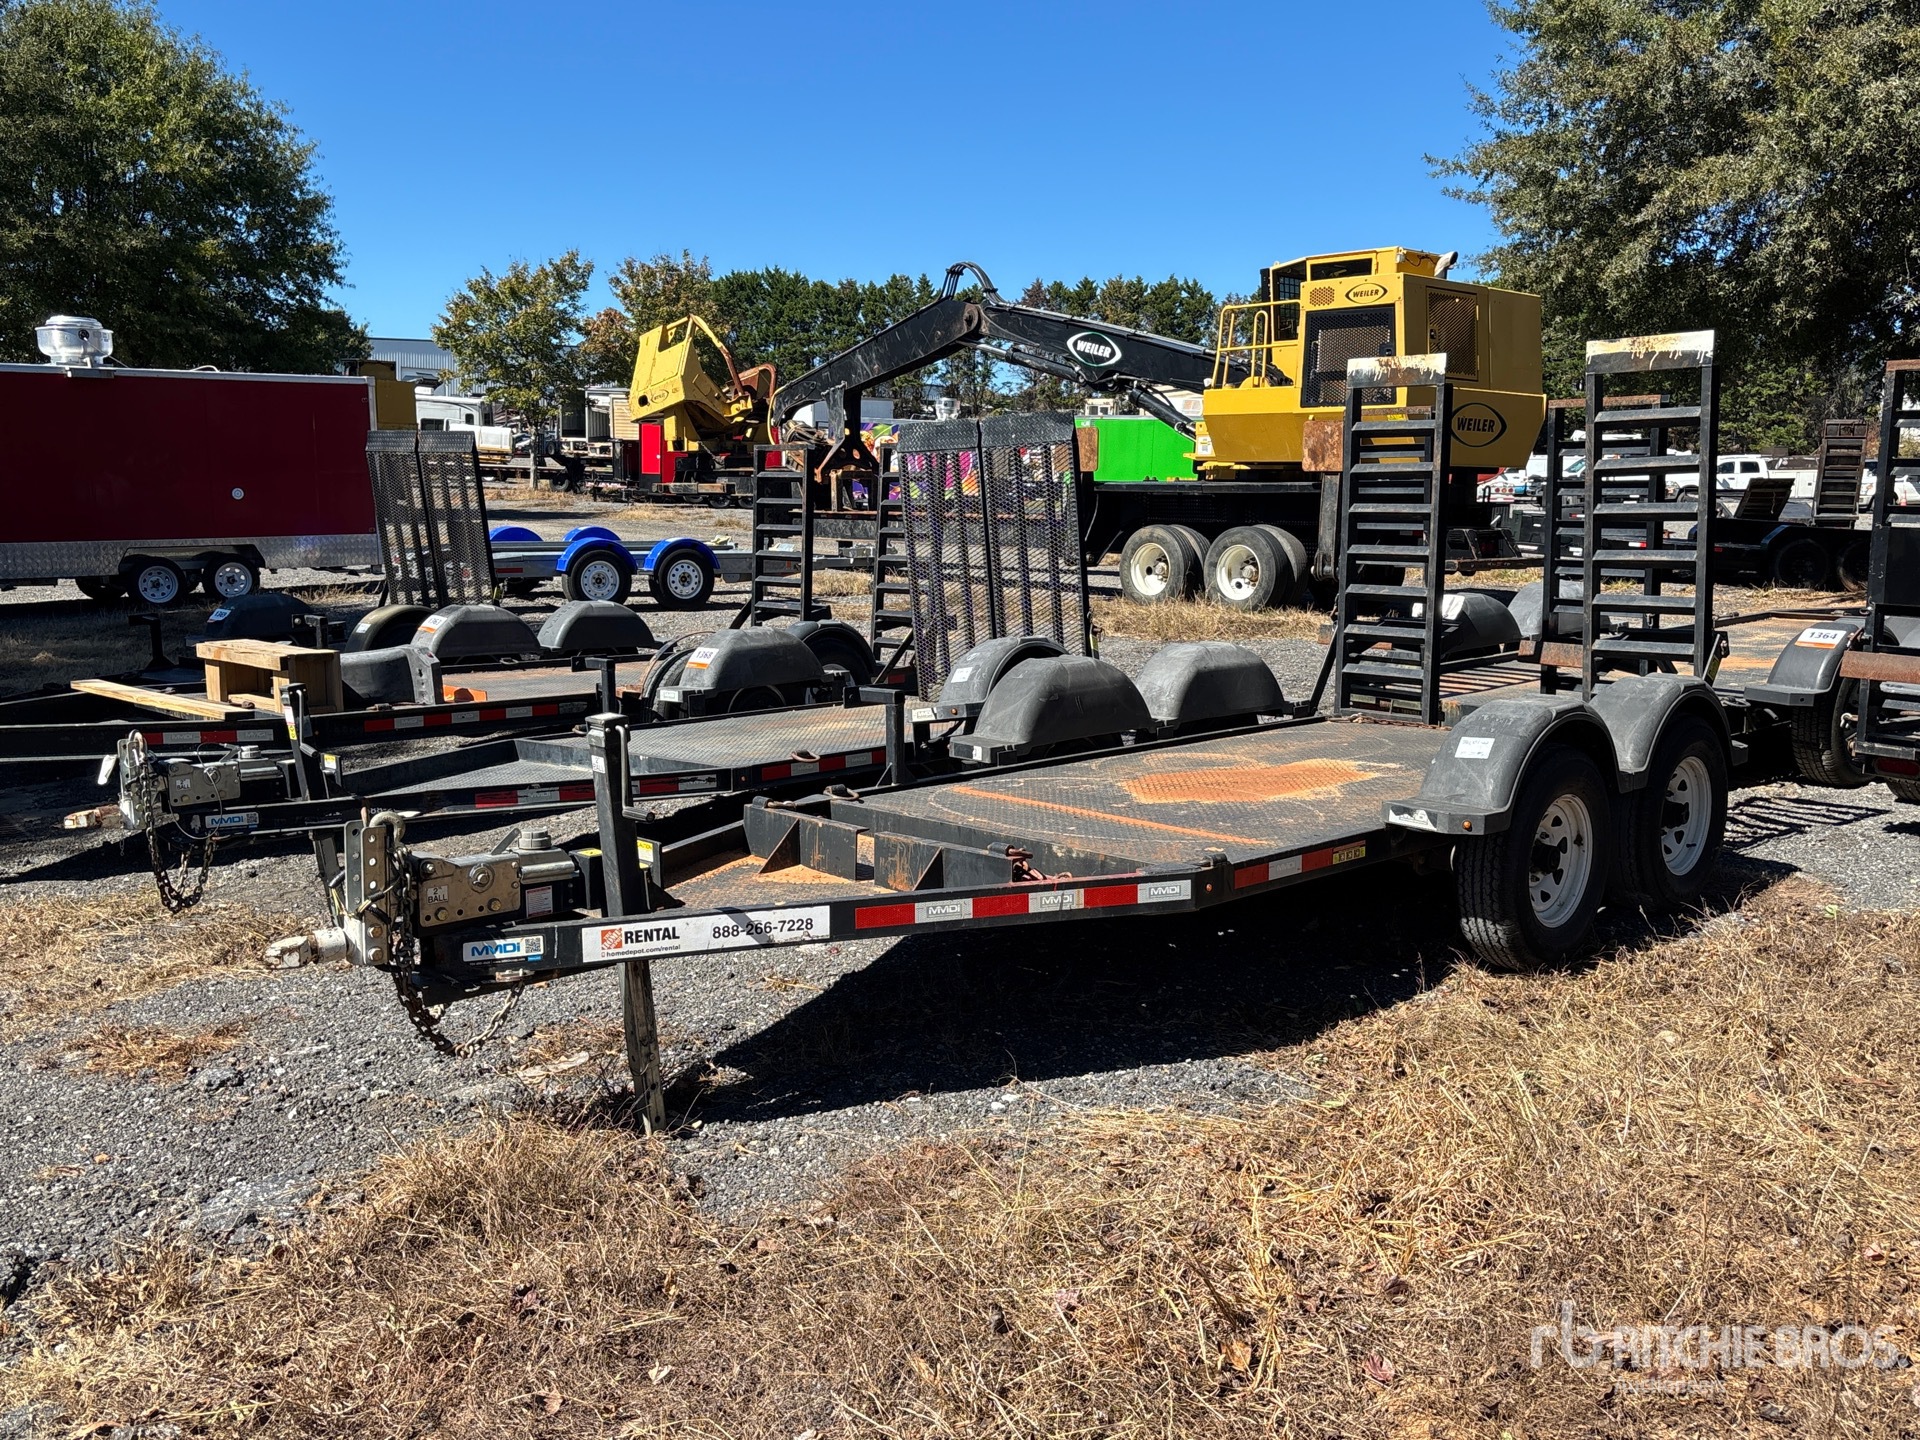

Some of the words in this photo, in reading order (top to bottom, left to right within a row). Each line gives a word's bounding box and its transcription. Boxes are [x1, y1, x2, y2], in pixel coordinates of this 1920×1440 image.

[1353, 289, 1379, 298] WEILER
[1076, 340, 1112, 358] WEILER
[1457, 416, 1496, 432] WEILER
[1808, 631, 1838, 640] 1364
[428, 894, 448, 904] BALL
[624, 926, 680, 945] RENTAL
[712, 918, 814, 939] 888-266-7228
[602, 928, 622, 949] HOME
[606, 944, 681, 957] homedepot.com/rental
